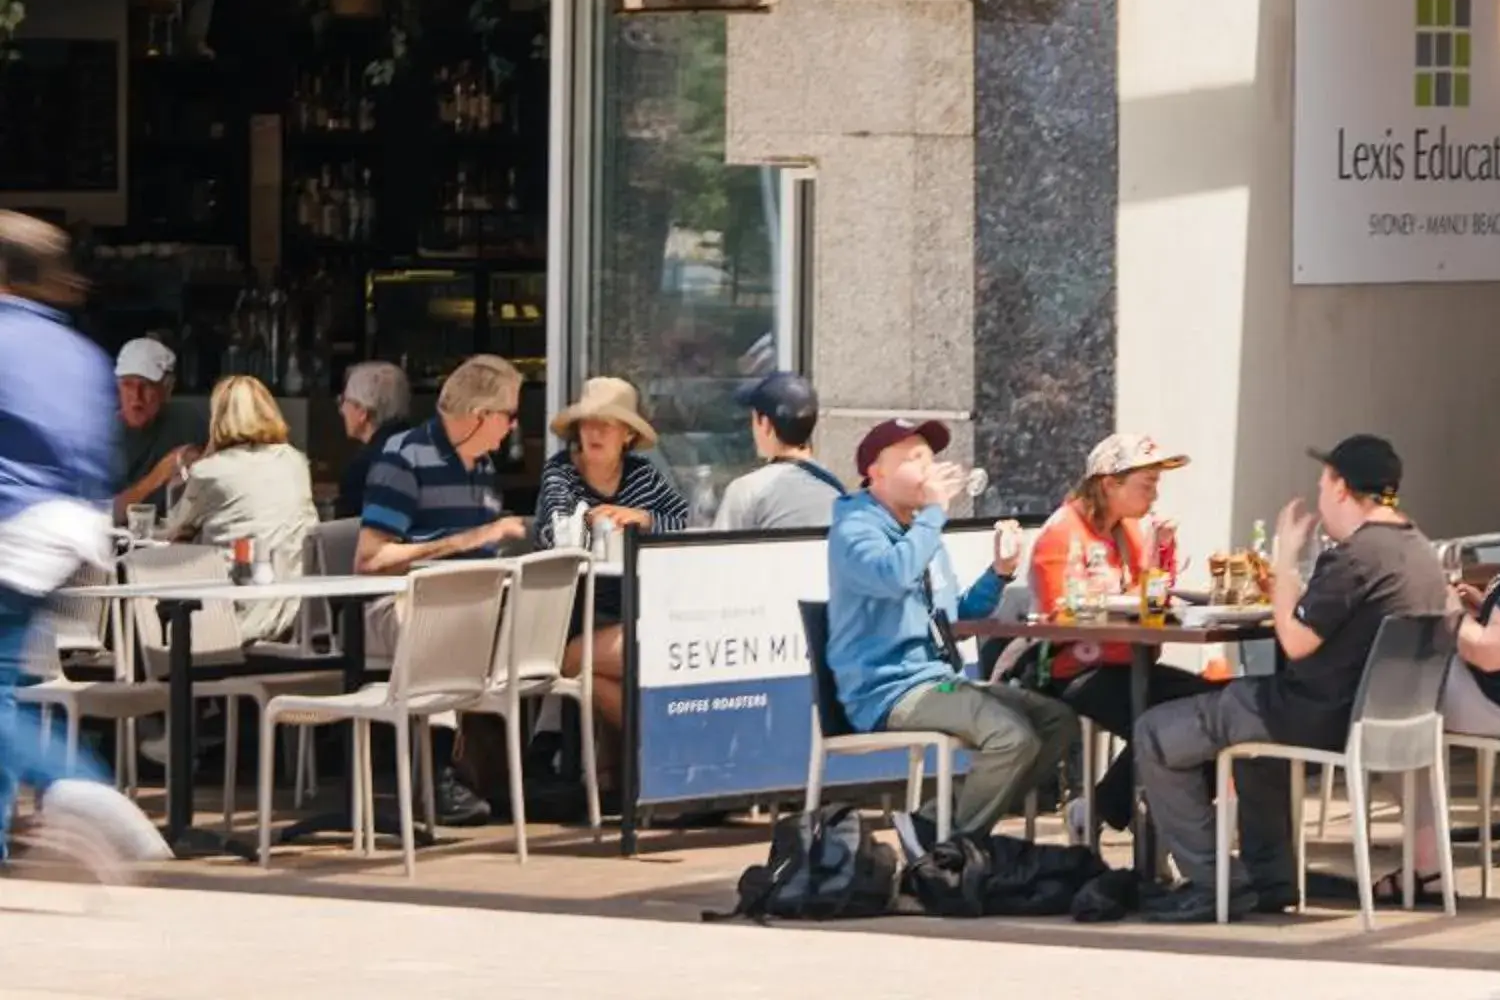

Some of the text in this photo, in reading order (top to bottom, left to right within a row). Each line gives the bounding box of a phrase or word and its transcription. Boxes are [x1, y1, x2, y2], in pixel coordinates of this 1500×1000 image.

[1337, 125, 1405, 182] Lexis
[668, 632, 811, 671] SEVEN MI
[667, 691, 768, 716] COFFEE ROASTERS
